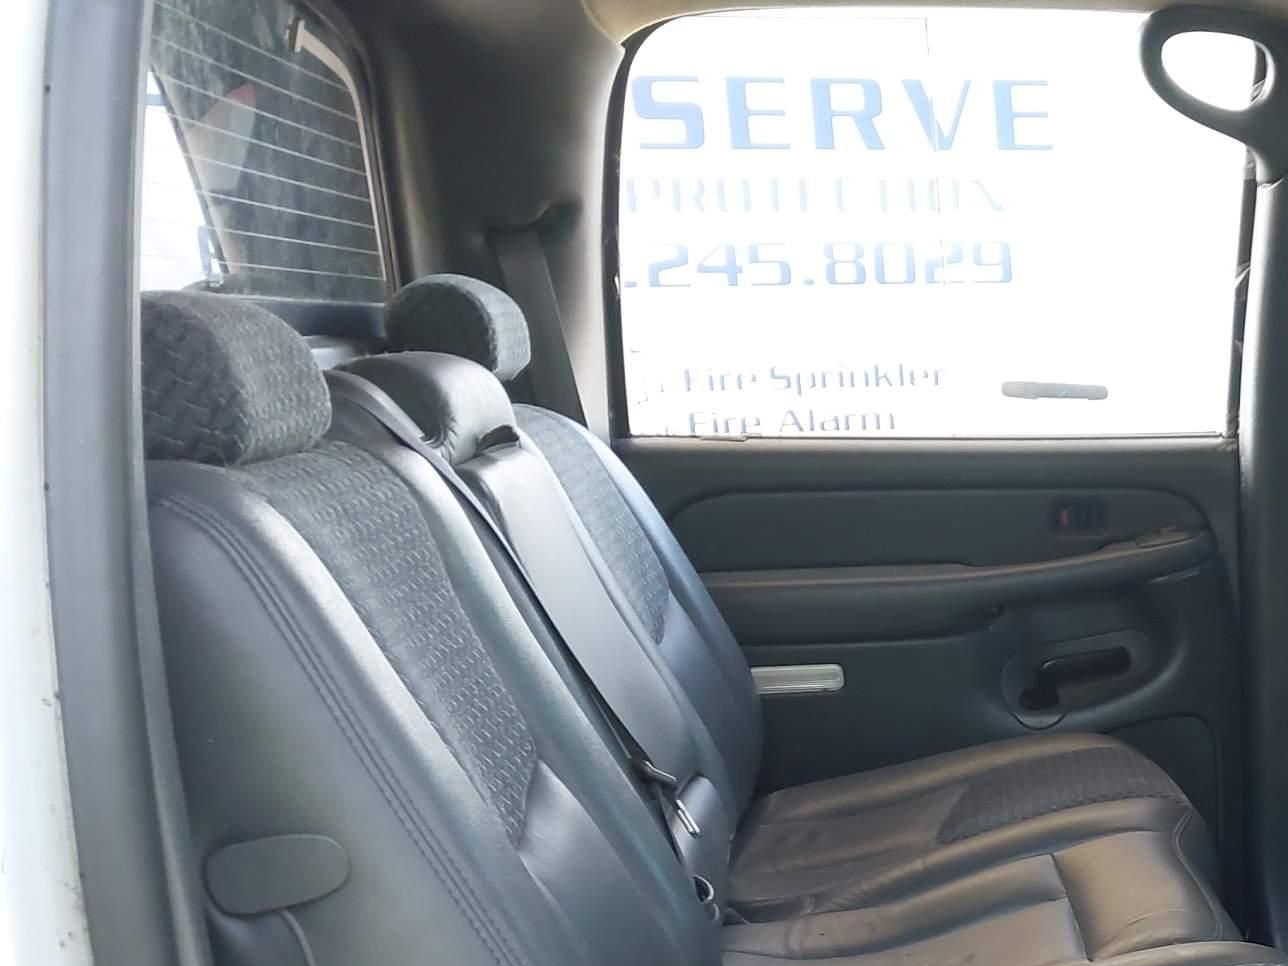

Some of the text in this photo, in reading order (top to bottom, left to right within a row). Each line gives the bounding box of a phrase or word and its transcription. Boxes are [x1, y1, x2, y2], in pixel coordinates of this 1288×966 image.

[632, 76, 1053, 152] SERVE
[684, 363, 947, 395] Fire Sprinkler
[688, 408, 897, 435] Fire Alarm
